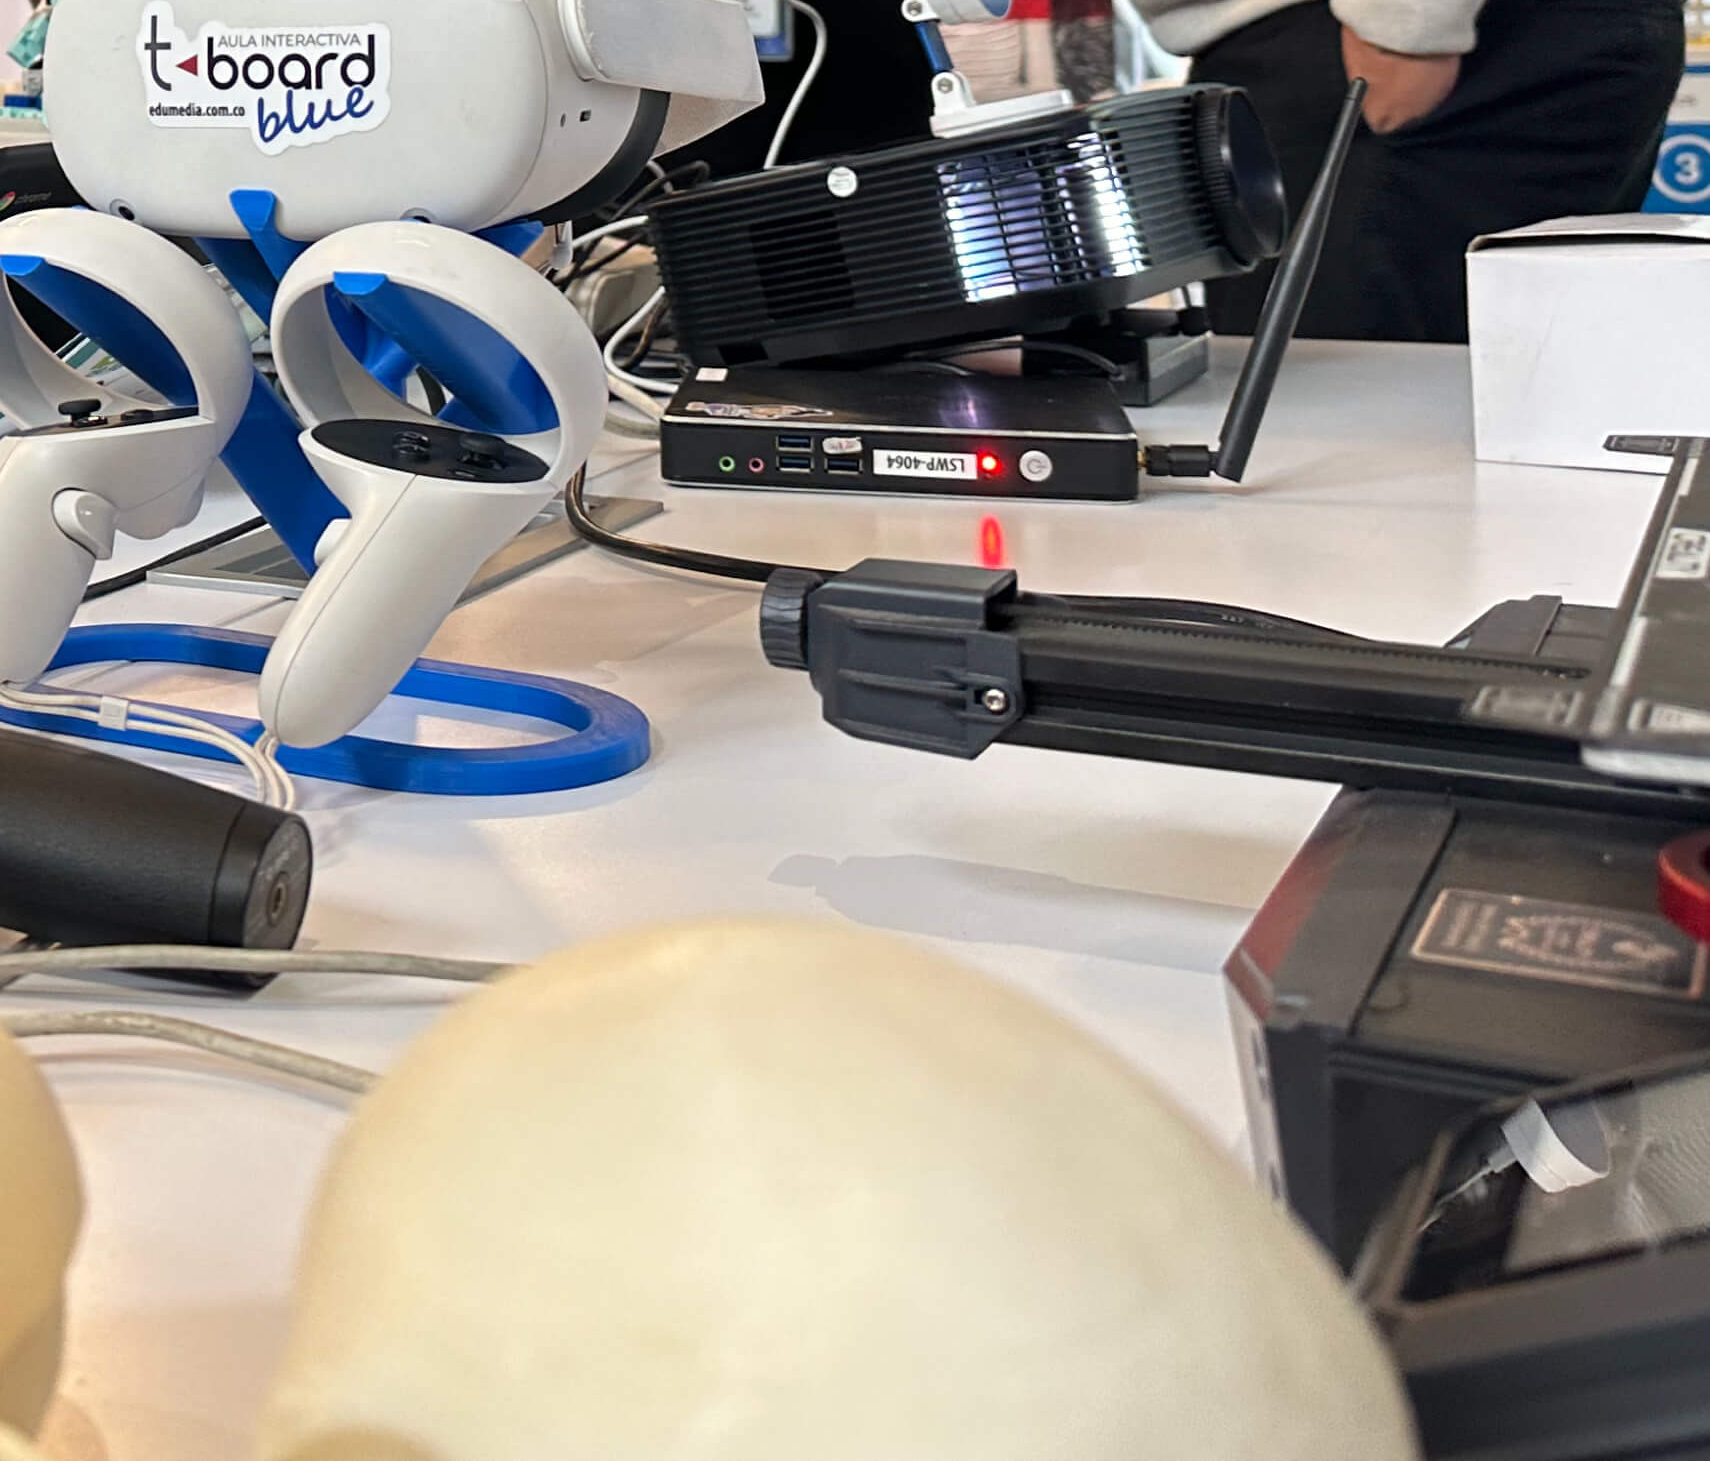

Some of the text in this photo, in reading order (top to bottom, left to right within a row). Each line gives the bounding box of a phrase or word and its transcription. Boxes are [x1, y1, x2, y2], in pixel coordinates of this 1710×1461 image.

[144, 15, 375, 91] t board
[217, 33, 362, 48] AULA INTERACTIVA
[149, 103, 246, 117] edumedia.com.co
[257, 87, 374, 143] blue
[1674, 152, 1701, 185] 3
[886, 455, 966, 473] LSWP-4064
